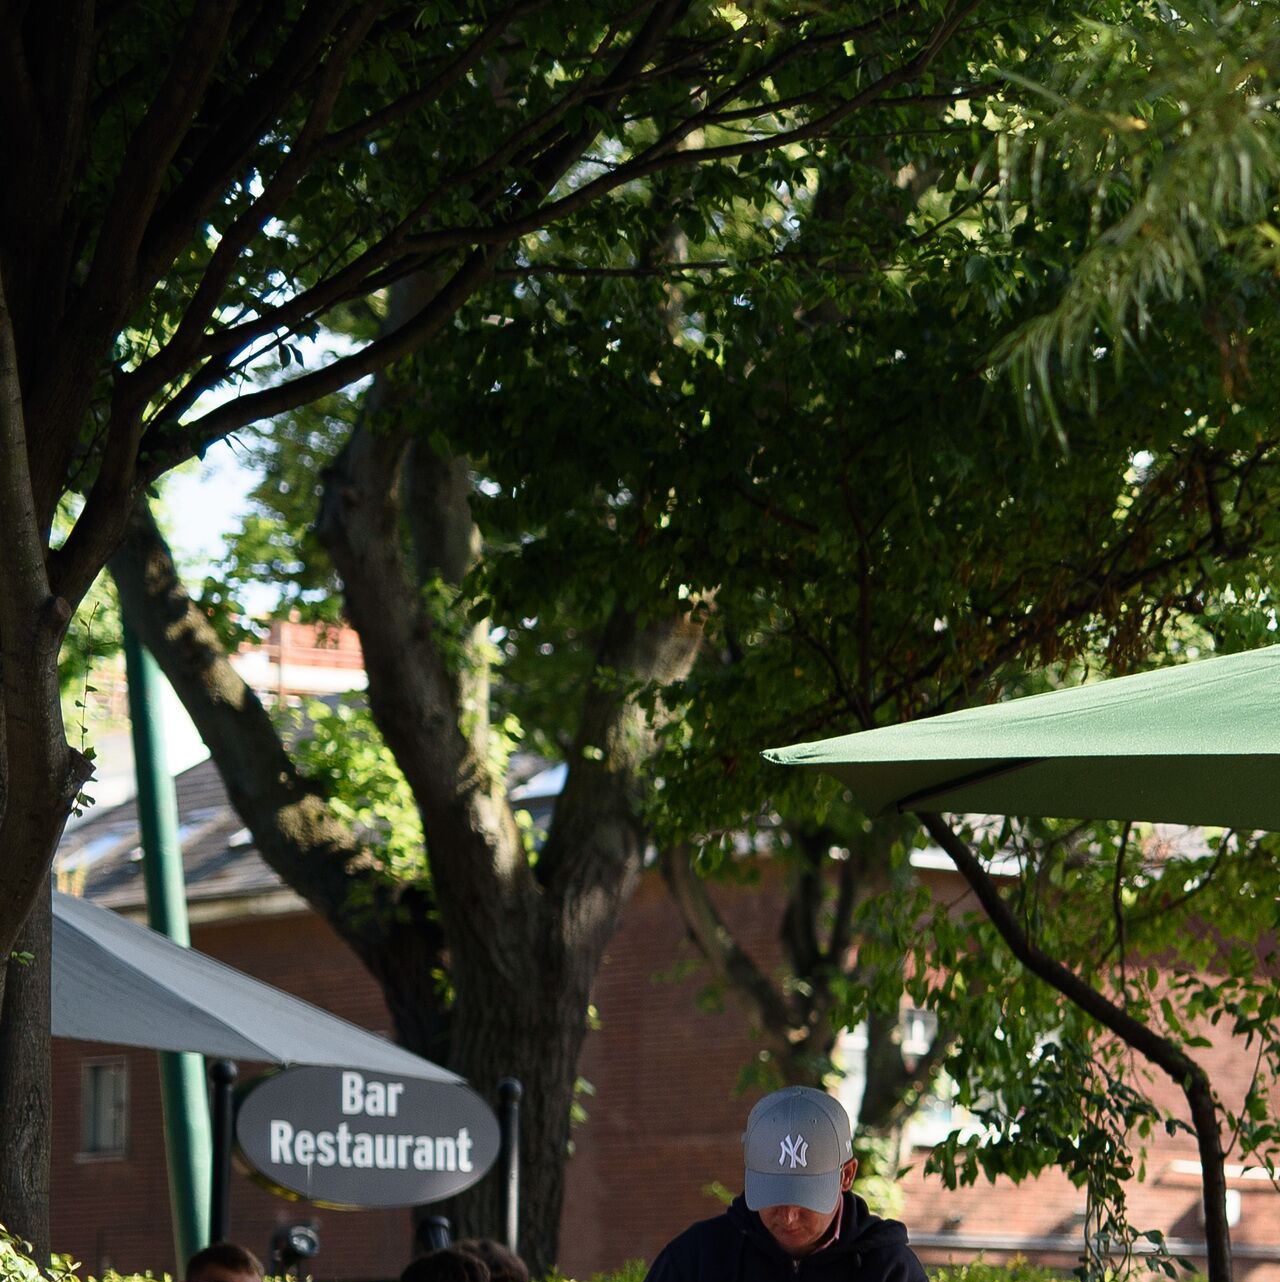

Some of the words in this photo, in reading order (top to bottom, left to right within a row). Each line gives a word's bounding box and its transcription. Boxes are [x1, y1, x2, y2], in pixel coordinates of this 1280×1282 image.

[341, 1071, 404, 1117] Bar
[270, 1119, 474, 1173] Restaurant
[779, 1134, 808, 1168] NY
